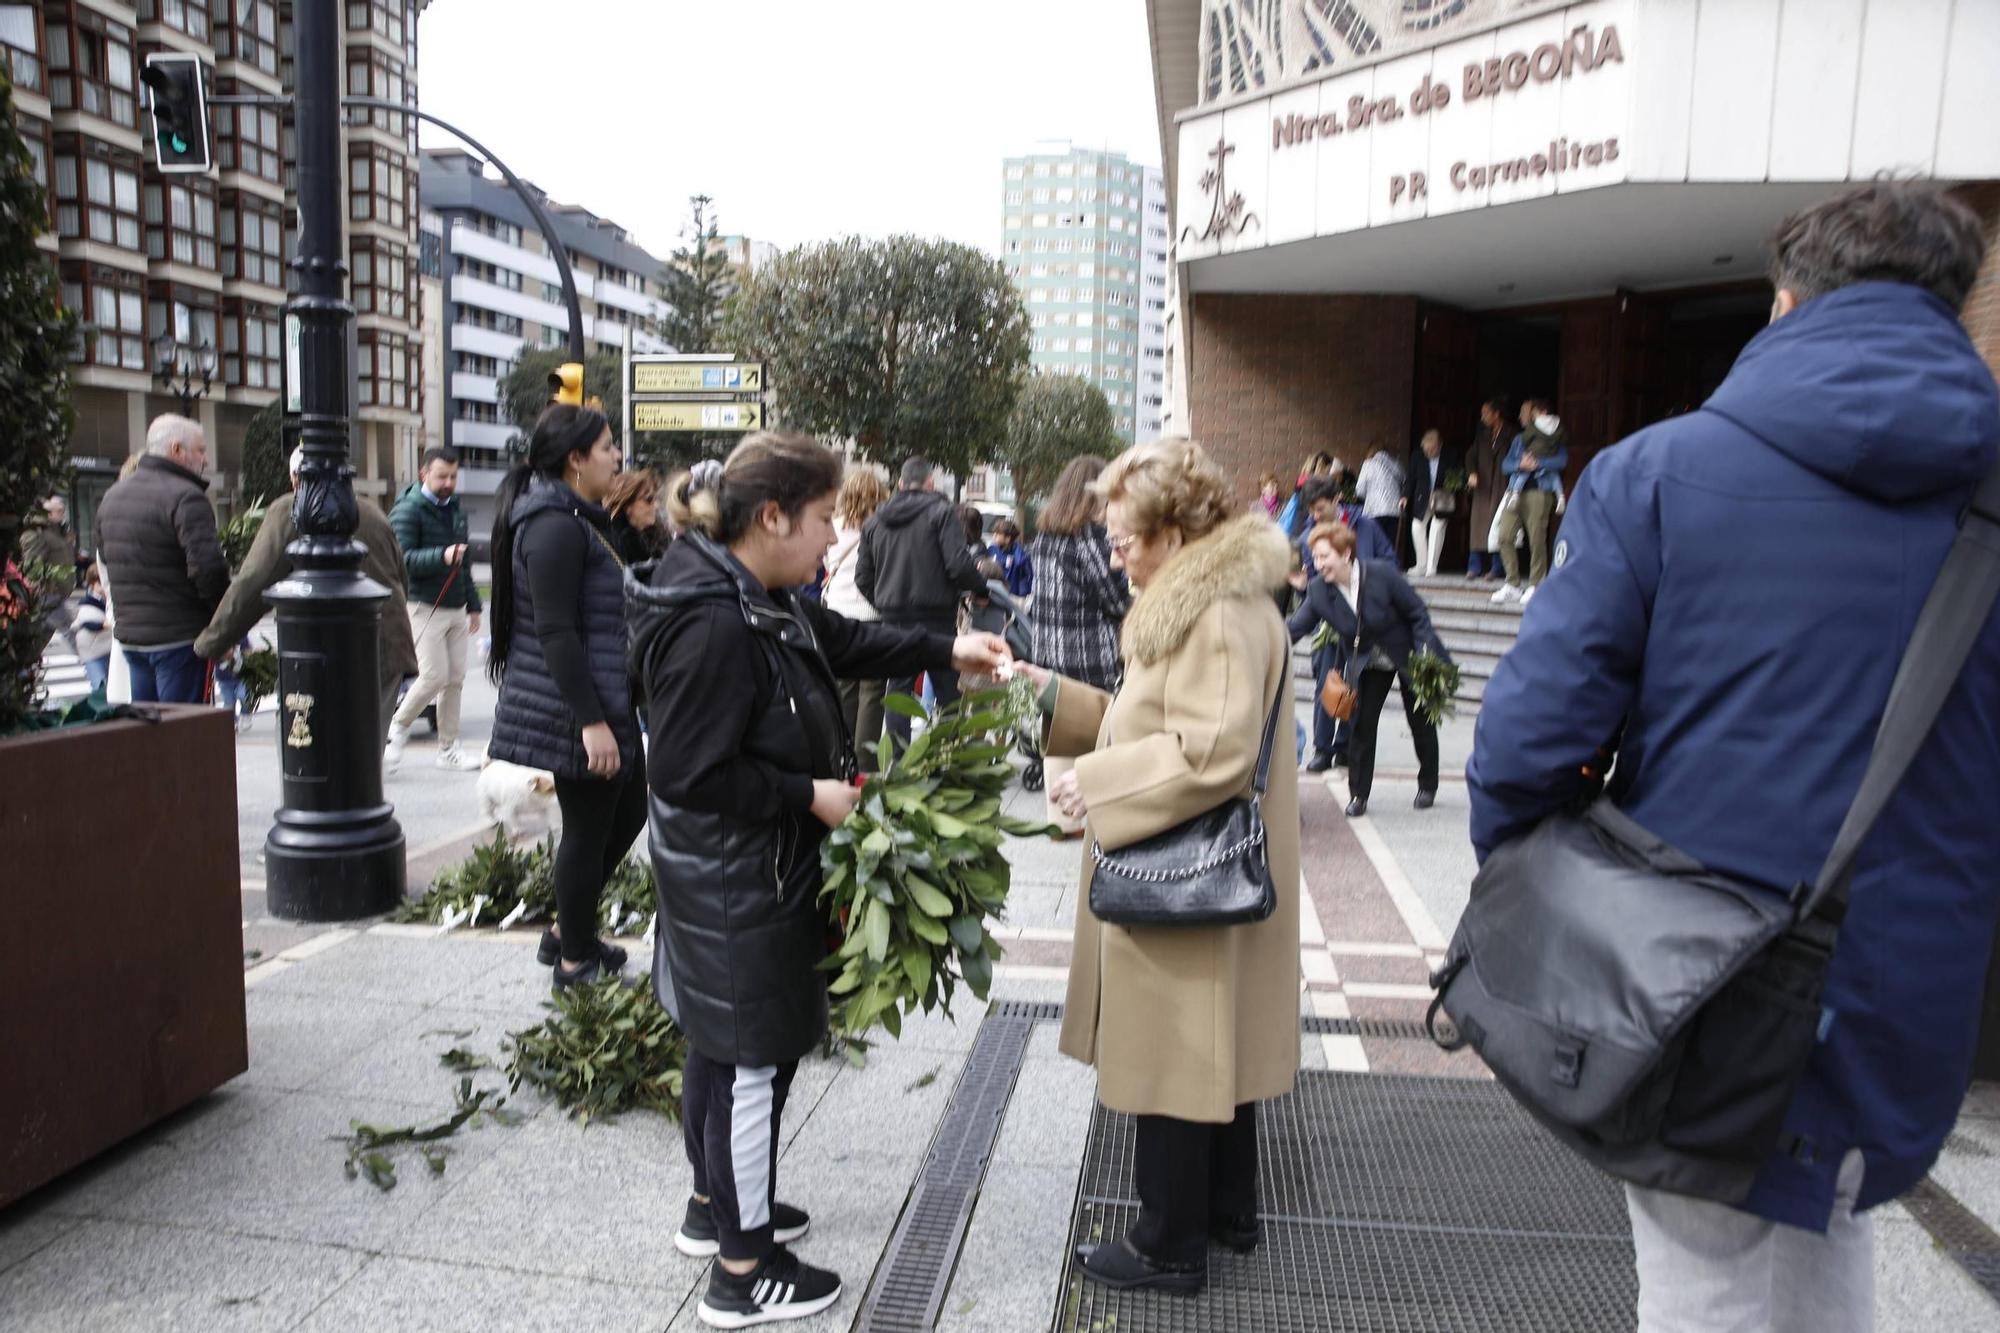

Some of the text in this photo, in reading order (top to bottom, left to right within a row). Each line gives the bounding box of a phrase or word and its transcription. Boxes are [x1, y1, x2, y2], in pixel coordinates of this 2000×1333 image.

[1272, 24, 1624, 151] Ntra. Sra. de BEGOÑA
[1450, 137, 1620, 190] Carmelitas
[637, 407, 660, 416] Hotel
